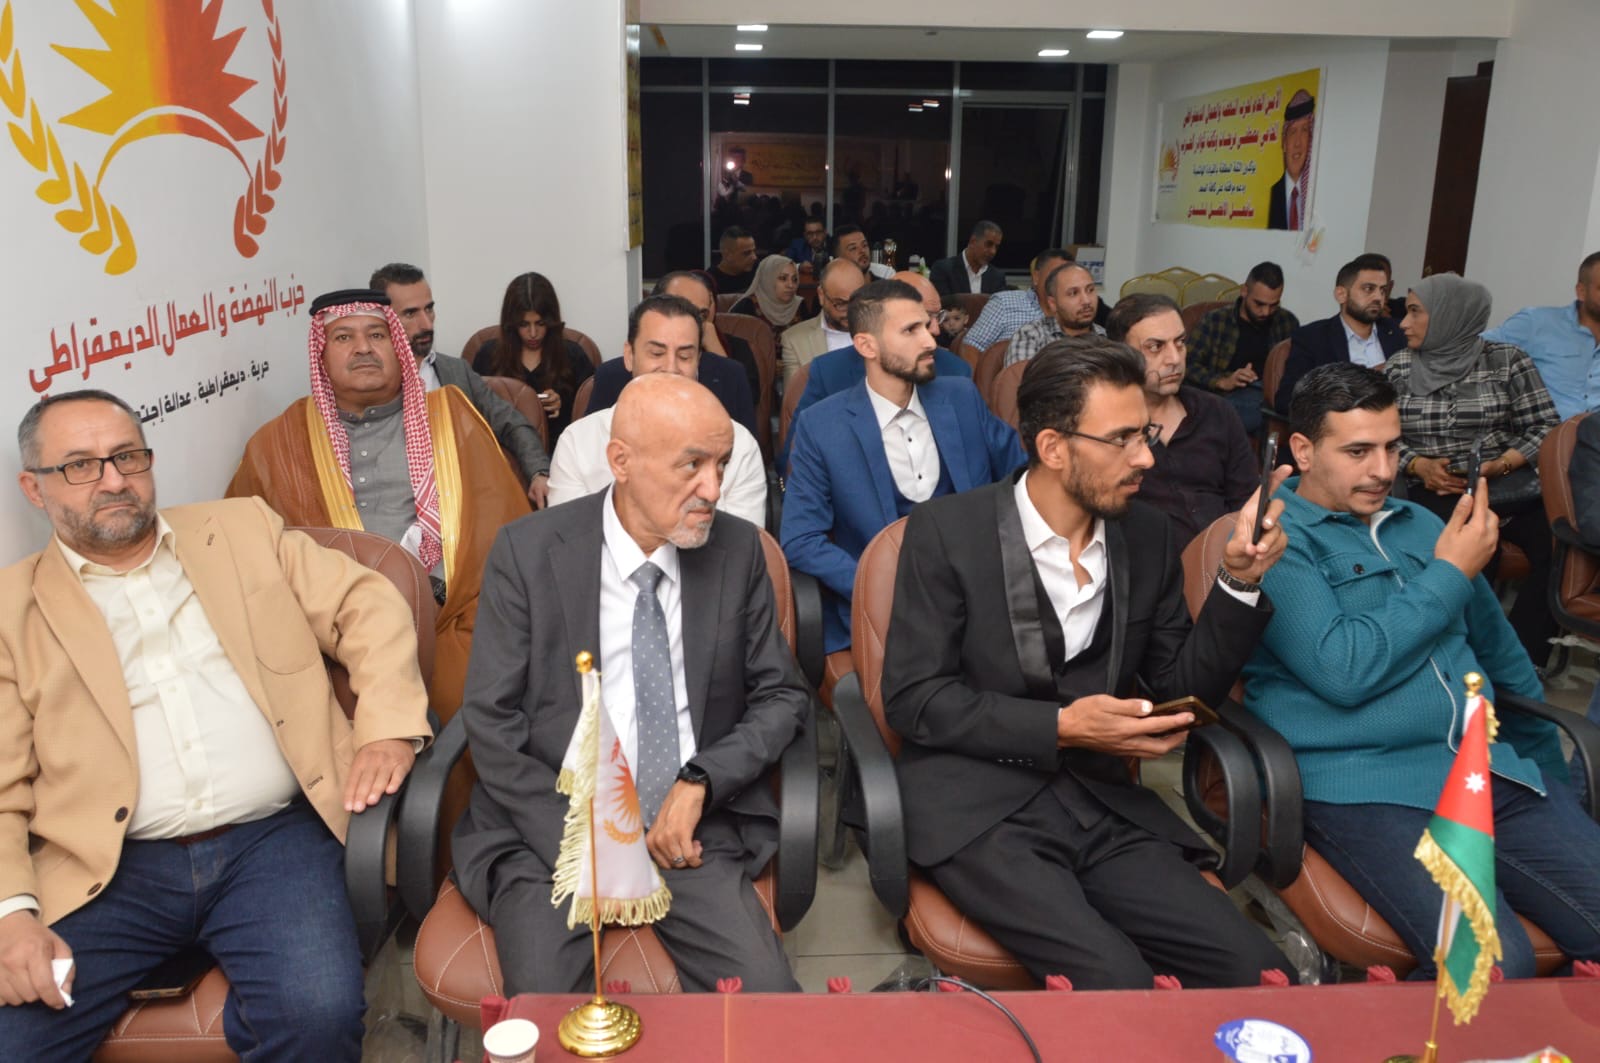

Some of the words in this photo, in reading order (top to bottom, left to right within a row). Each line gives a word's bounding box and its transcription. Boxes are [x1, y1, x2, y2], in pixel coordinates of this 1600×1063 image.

[229, 276, 279, 326] النهضة
[280, 273, 306, 317] حزب
[28, 303, 161, 401] الديمقراطي
[251, 360, 270, 380] حرية
[164, 390, 192, 414] عدالة
[198, 371, 246, 405] ديمقراطية
